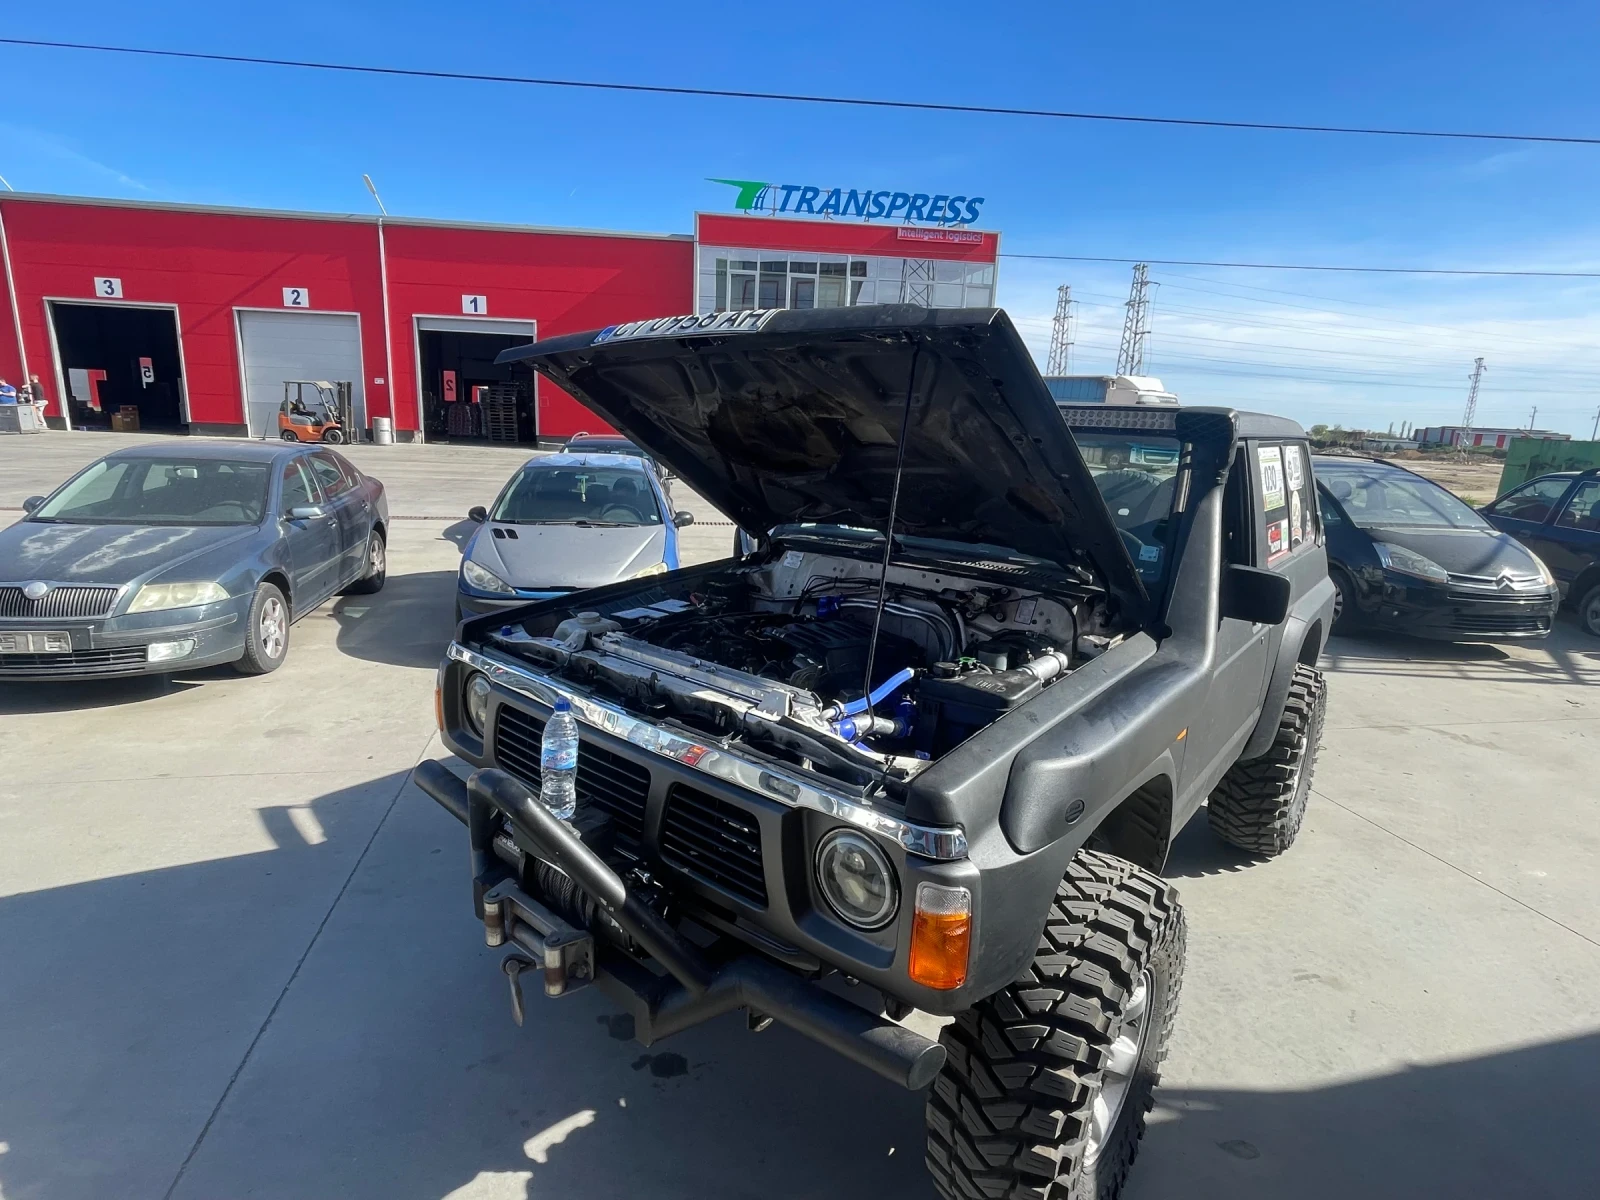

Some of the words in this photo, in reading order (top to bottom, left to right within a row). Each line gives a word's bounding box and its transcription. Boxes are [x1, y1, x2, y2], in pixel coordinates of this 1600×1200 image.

[779, 185, 985, 224] TRANSPRESS
[899, 227, 944, 241] Intelligent
[945, 231, 982, 243] logistics
[103, 279, 115, 296] 3
[291, 289, 301, 306] 2
[469, 296, 479, 313] 1
